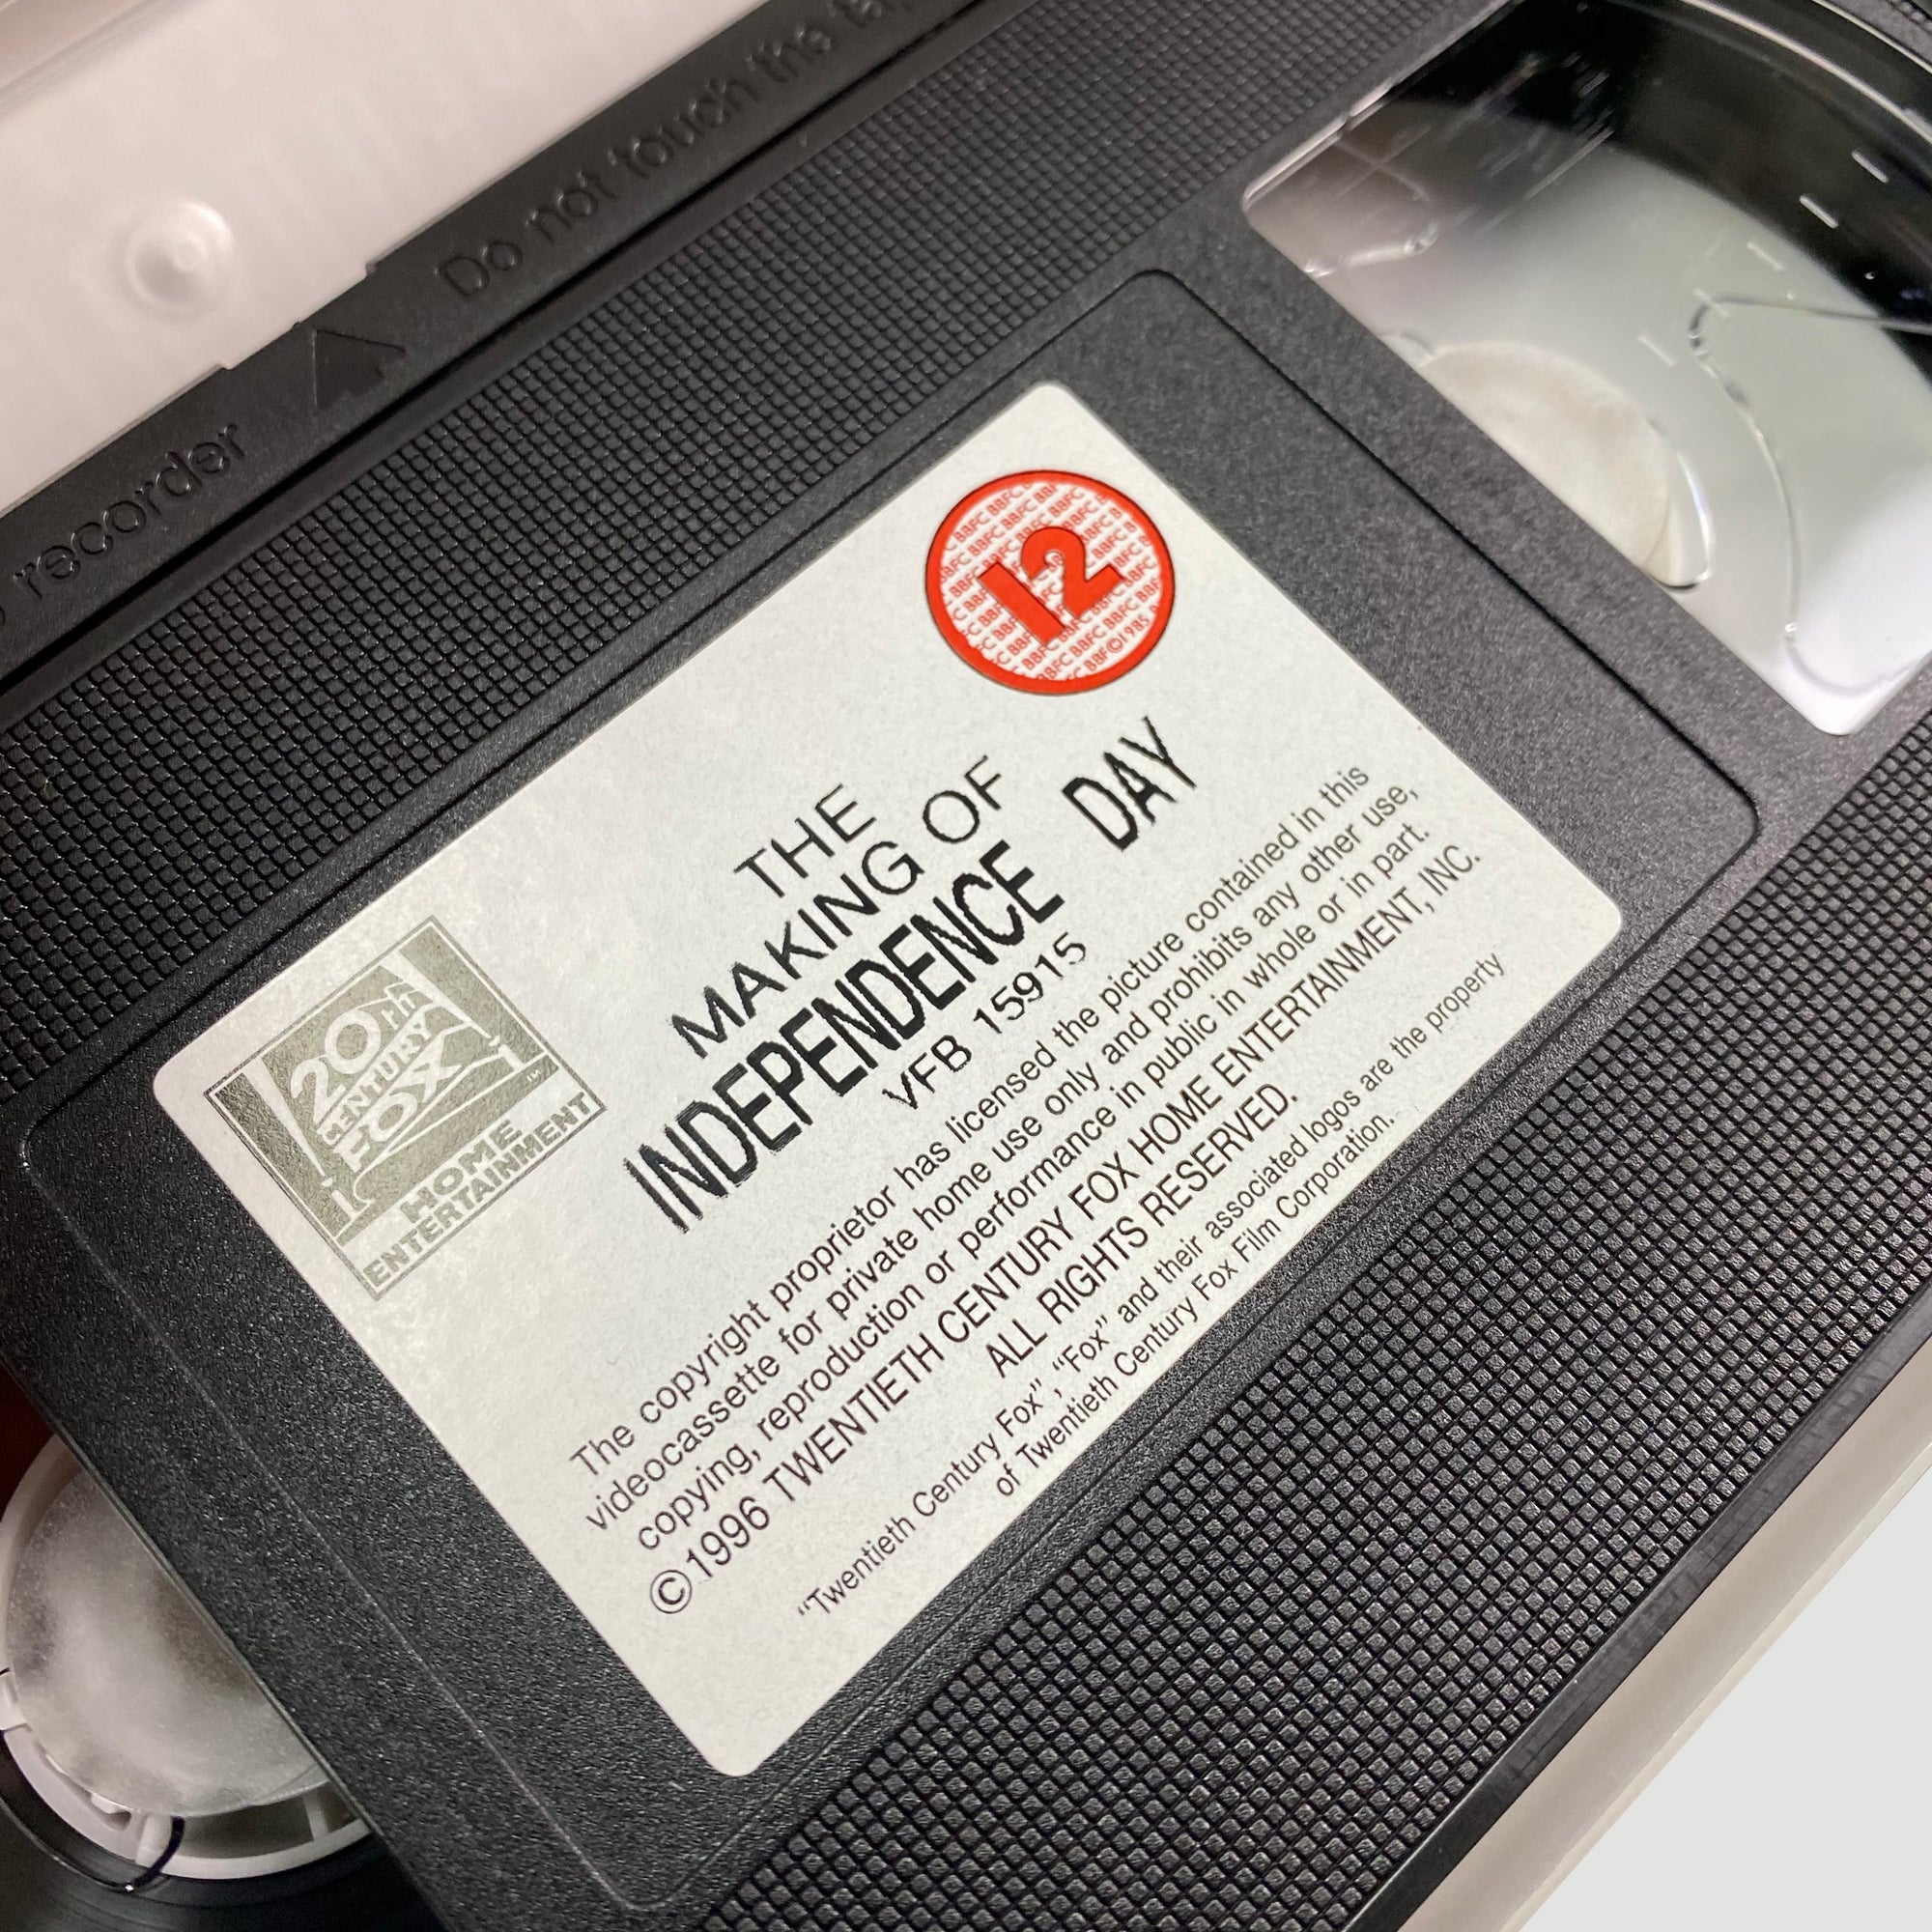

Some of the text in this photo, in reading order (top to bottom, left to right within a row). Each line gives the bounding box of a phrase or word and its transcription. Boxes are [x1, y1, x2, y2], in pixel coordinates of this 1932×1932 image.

[435, 23, 838, 300] Do not touch the
[13, 422, 245, 600] recorder
[978, 526, 1124, 647] 12
[622, 715, 1198, 1235] INDEPENDENCE DAY
[668, 754, 1003, 1060] MAKING OF
[732, 782, 878, 898] THE
[291, 984, 416, 1125] 20th
[317, 1009, 432, 1152] CENTURY
[333, 1030, 463, 1174] FOX
[569, 767, 1370, 1476] The copyright proprietor has licensed the picture contained in this
[585, 786, 1419, 1530] videocassette for private home use only and prohibits any other use,
[881, 931, 1087, 1111] VFB 15915
[362, 1092, 591, 1288] ENTERTAINMENT
[400, 1119, 523, 1224] HOME
[638, 823, 1430, 1550] copying, reproduction or performance in public in whole or in part.
[761, 1331, 946, 1502] TWENTIETH
[937, 1205, 1074, 1344] CENTURY
[1067, 1150, 1141, 1222] FOX
[1126, 1074, 1223, 1166] HOME
[1209, 885, 1435, 1089] ENTERTAINMENT,
[1417, 844, 1481, 896] INC.
[912, 1432, 1002, 1518] Century
[1117, 1275, 1160, 1324] and
[1152, 1235, 1204, 1285] their
[1205, 1133, 1309, 1240] associated
[1299, 1090, 1361, 1144] logos
[1359, 1058, 1394, 1093] are
[1389, 1027, 1428, 1060] the
[1424, 952, 1505, 1035] property
[985, 1083, 1298, 1379] ALL RIGHTS RESERVED.
[996, 1114, 1395, 1497] of Twentieth Century Fox Film Corporation.
